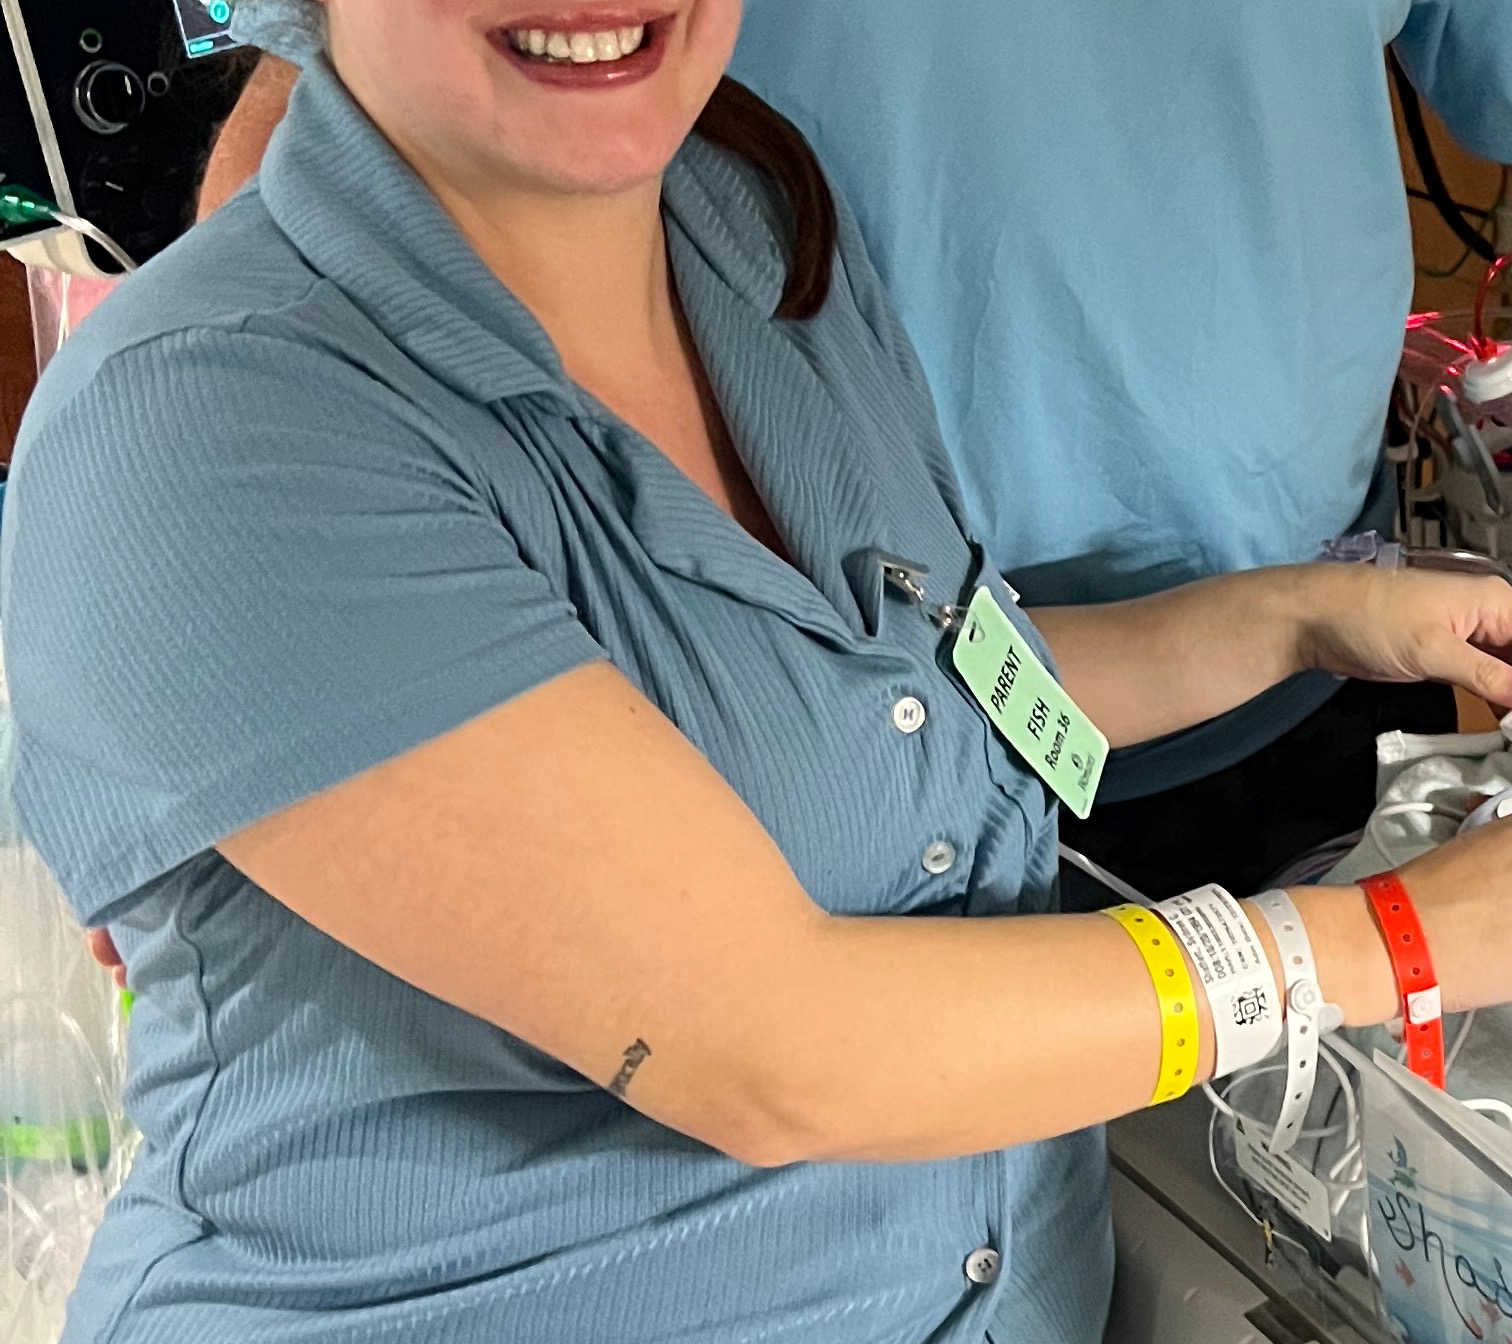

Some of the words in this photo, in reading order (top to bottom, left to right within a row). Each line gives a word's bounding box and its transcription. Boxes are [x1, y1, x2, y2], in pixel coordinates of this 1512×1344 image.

[990, 644, 1023, 715] PARENT
[1027, 696, 1051, 742] FISH
[1044, 731, 1067, 771] Room
[1057, 710, 1072, 735] 36
